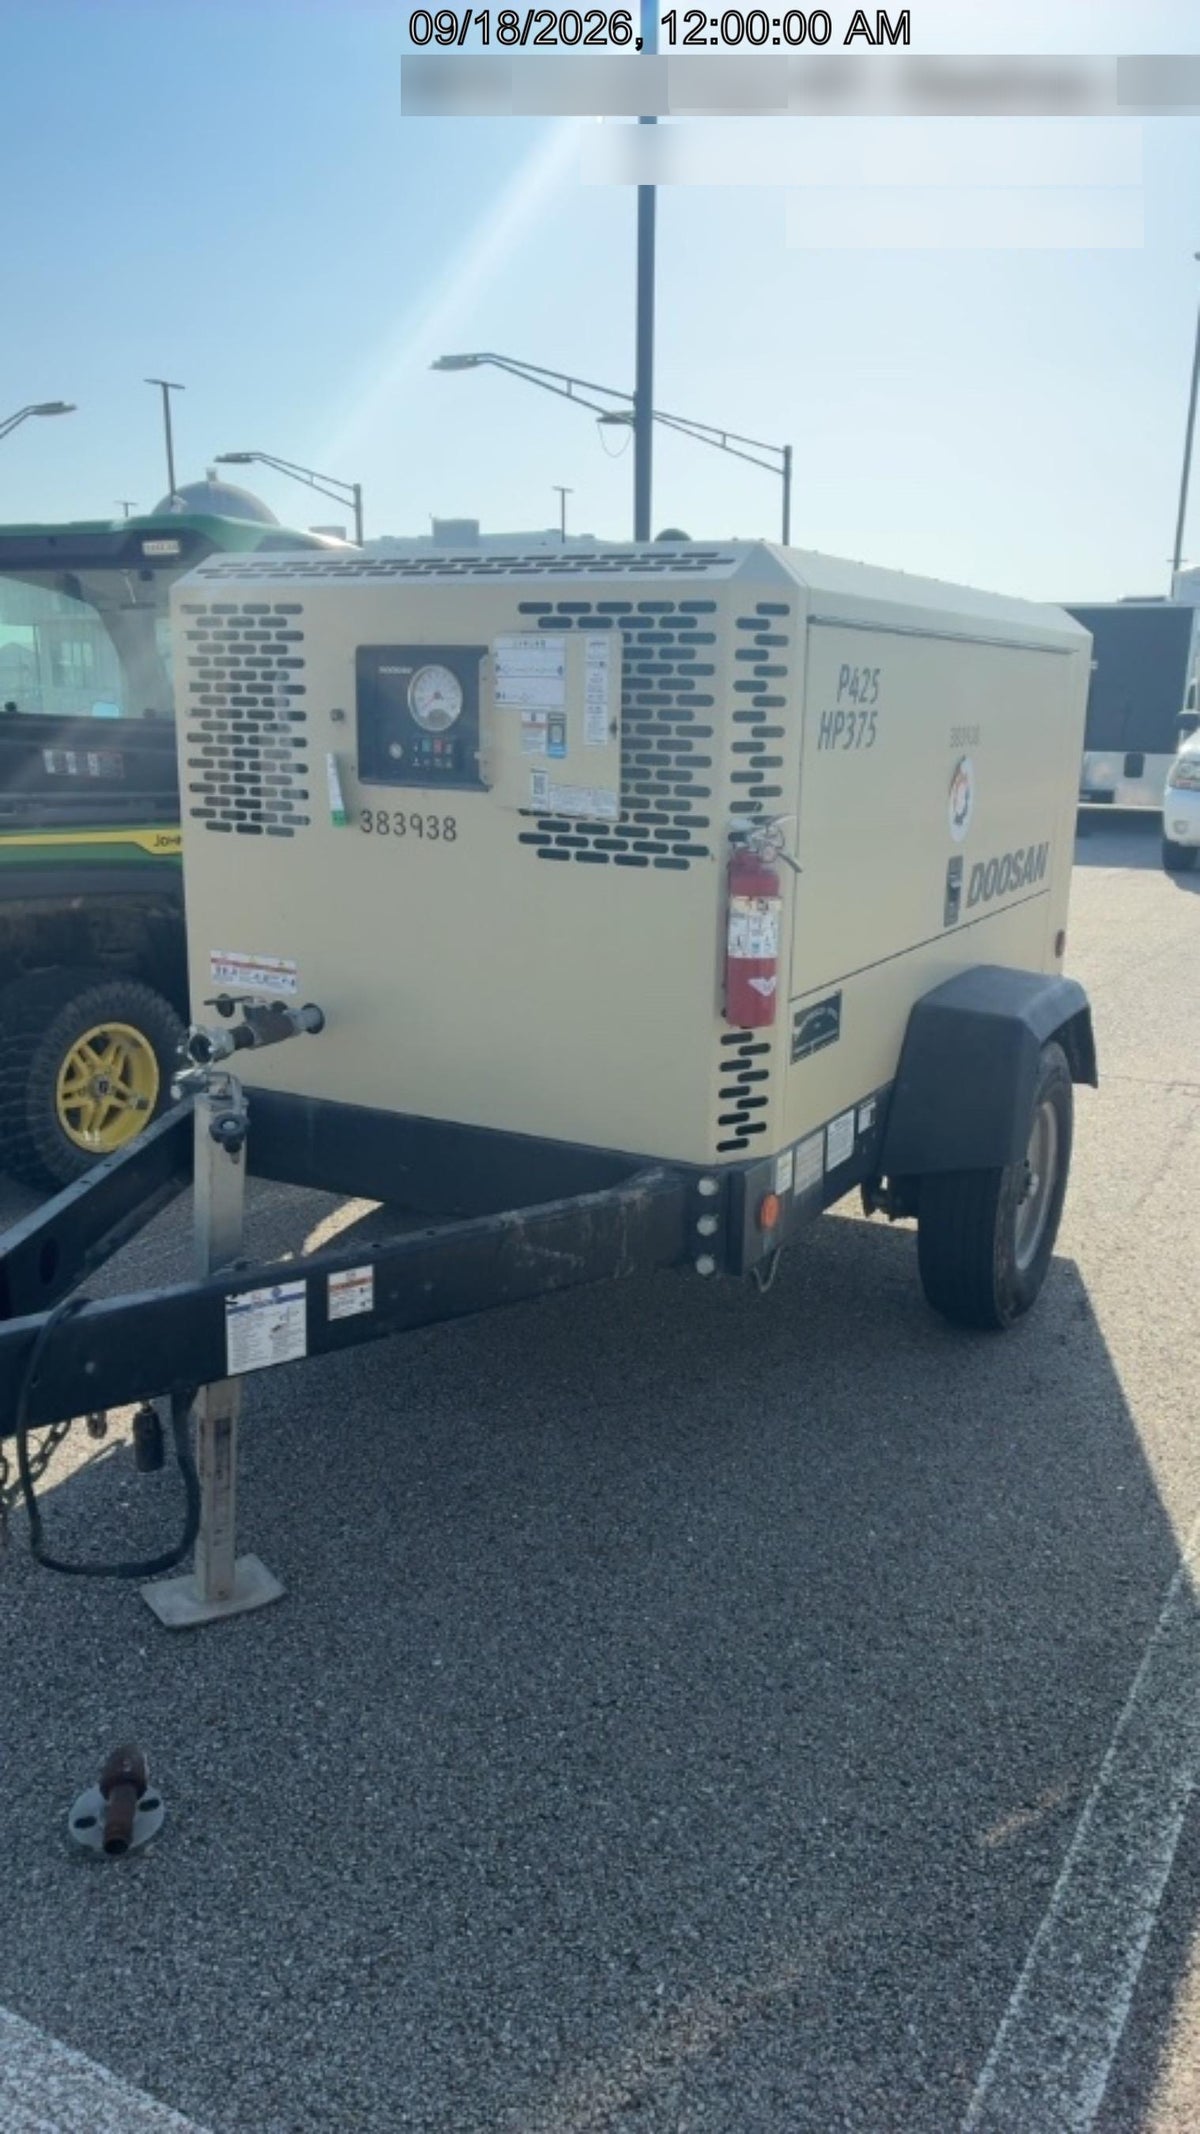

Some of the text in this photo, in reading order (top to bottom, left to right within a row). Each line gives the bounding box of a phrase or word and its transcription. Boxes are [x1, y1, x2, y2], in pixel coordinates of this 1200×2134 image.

[837, 663, 881, 704] P425
[817, 710, 878, 750] HP375
[360, 809, 457, 842] 383938
[966, 841, 1049, 908] DOOSAN
